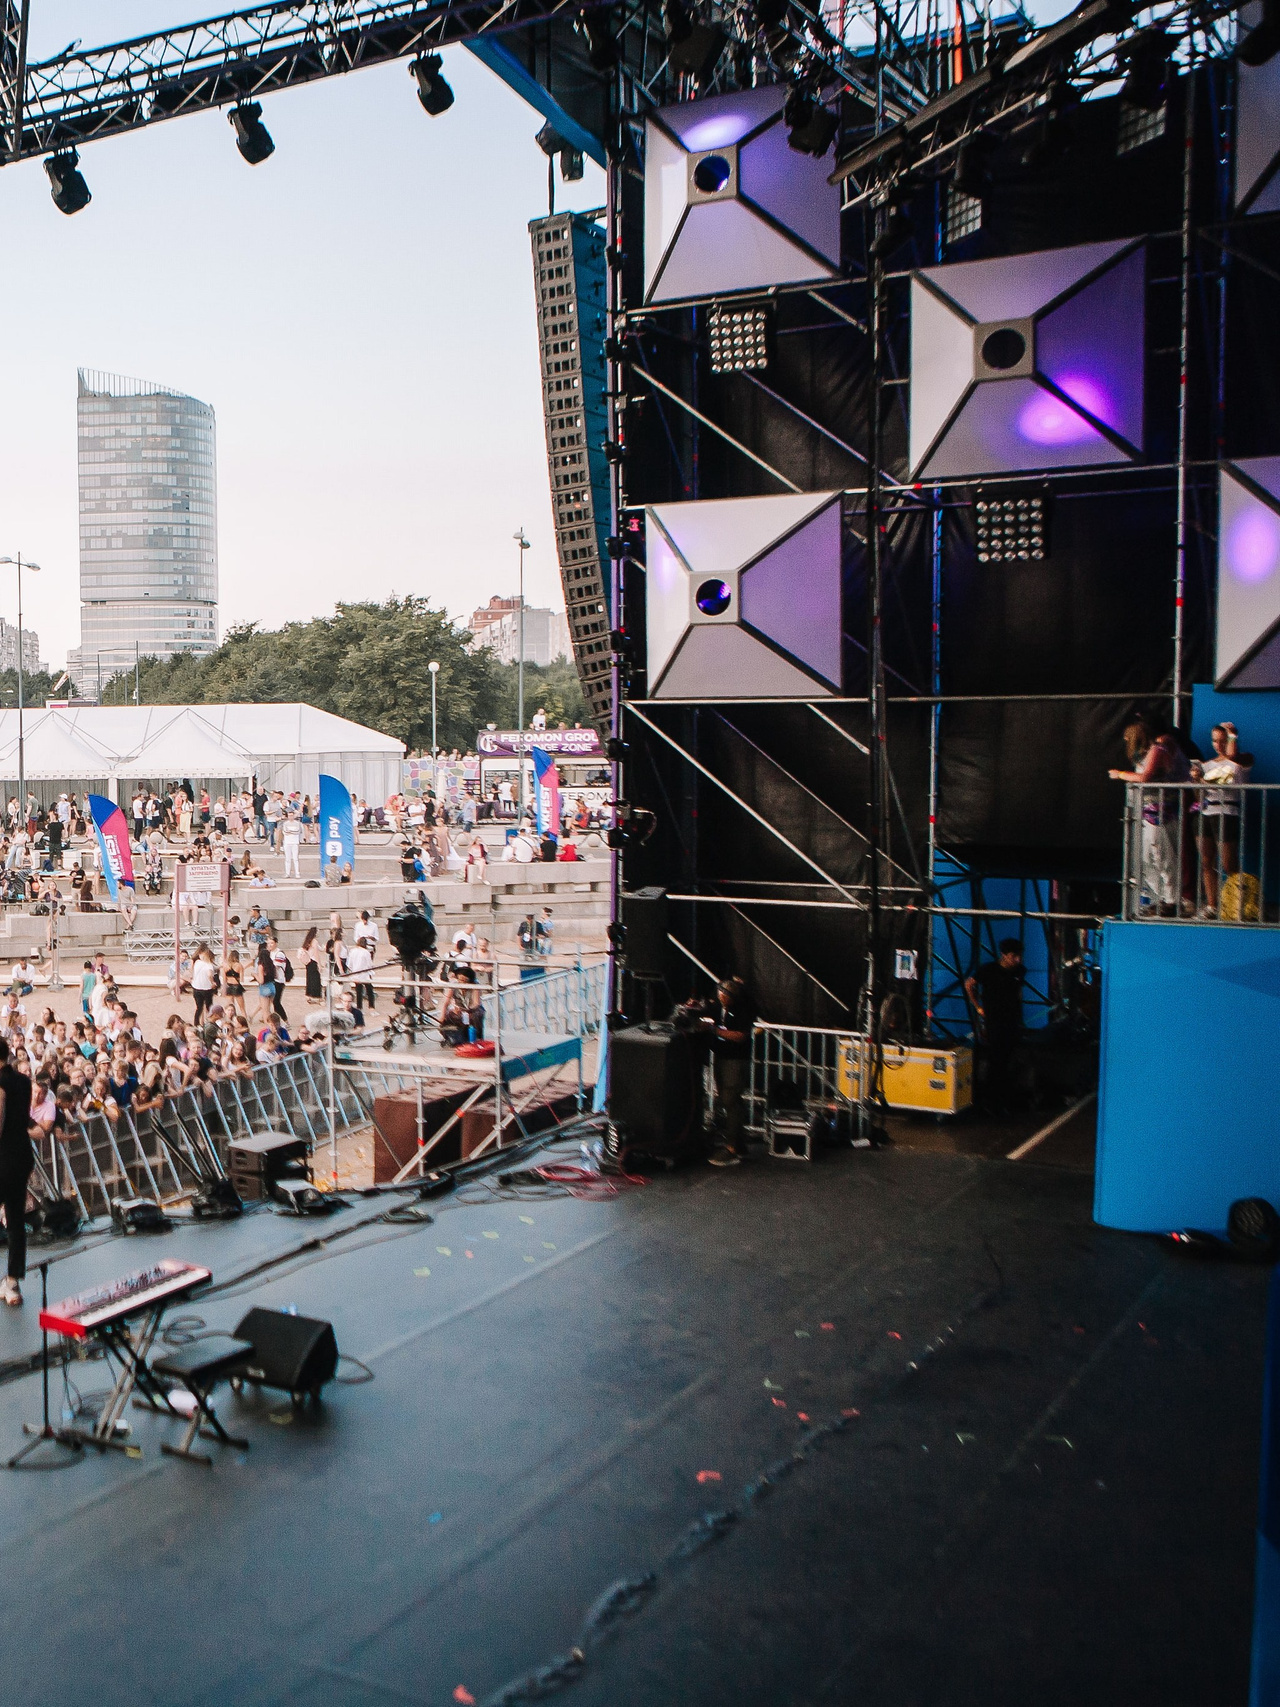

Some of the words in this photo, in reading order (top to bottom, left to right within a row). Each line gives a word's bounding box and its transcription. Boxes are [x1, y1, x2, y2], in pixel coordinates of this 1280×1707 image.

[561, 743, 593, 751] ZONE
[540, 784, 550, 831] VKFEST
[328, 816, 341, 838] pay
[102, 833, 122, 880] VKFEST
